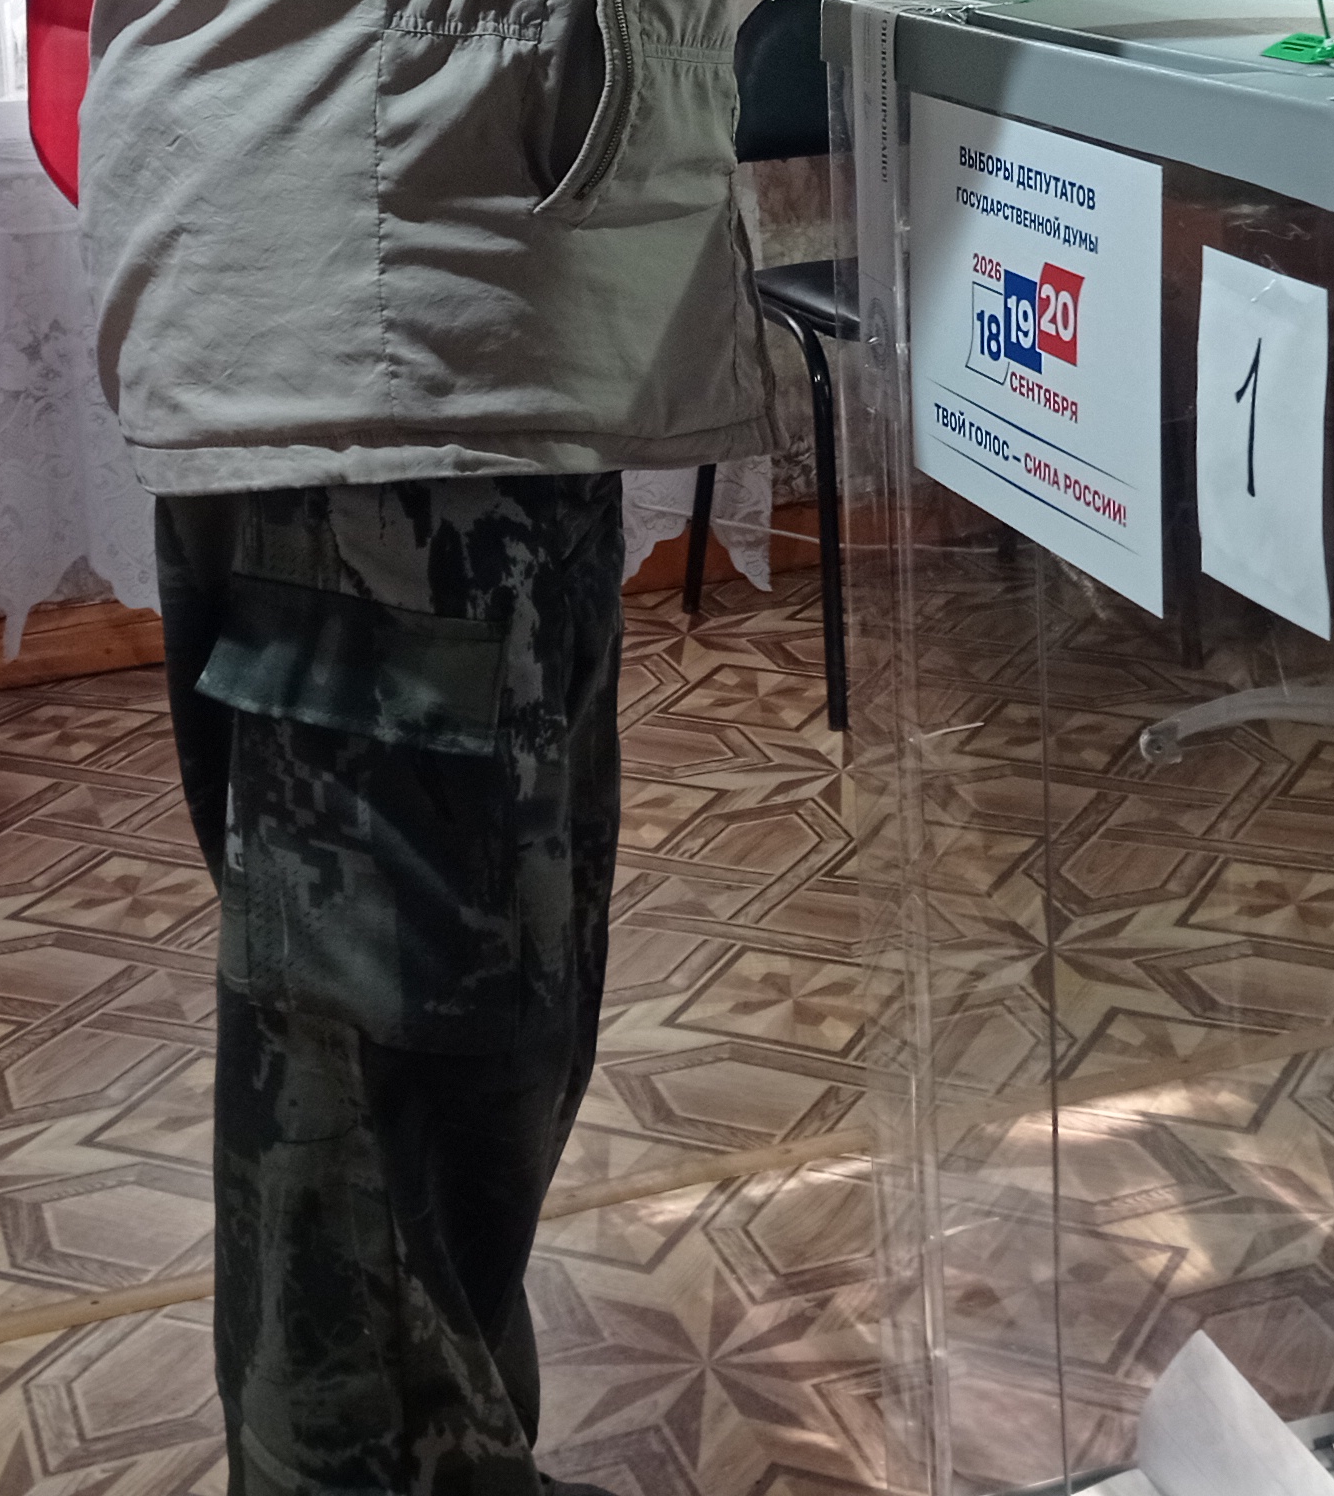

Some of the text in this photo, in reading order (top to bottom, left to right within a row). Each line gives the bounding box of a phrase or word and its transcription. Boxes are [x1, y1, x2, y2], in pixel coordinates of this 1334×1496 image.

[959, 145, 1096, 211] ВЫБОРЫ ДЕПУТАТОВ
[956, 186, 1099, 254] ГОСУДАРСТВЕННОЙ ДУМЫ
[973, 252, 1002, 282] 2026
[977, 309, 1002, 361] 18
[1007, 295, 1034, 349] 19
[1040, 283, 1075, 341] 20
[1010, 371, 1079, 424] СЕНТЯБРЯ
[1234, 336, 1262, 498] 1
[934, 402, 966, 437] ТВОЙ
[969, 421, 1010, 461] ГОЛОС
[1024, 452, 1061, 491] СИЛА
[1064, 473, 1127, 528] РОССИИ!
